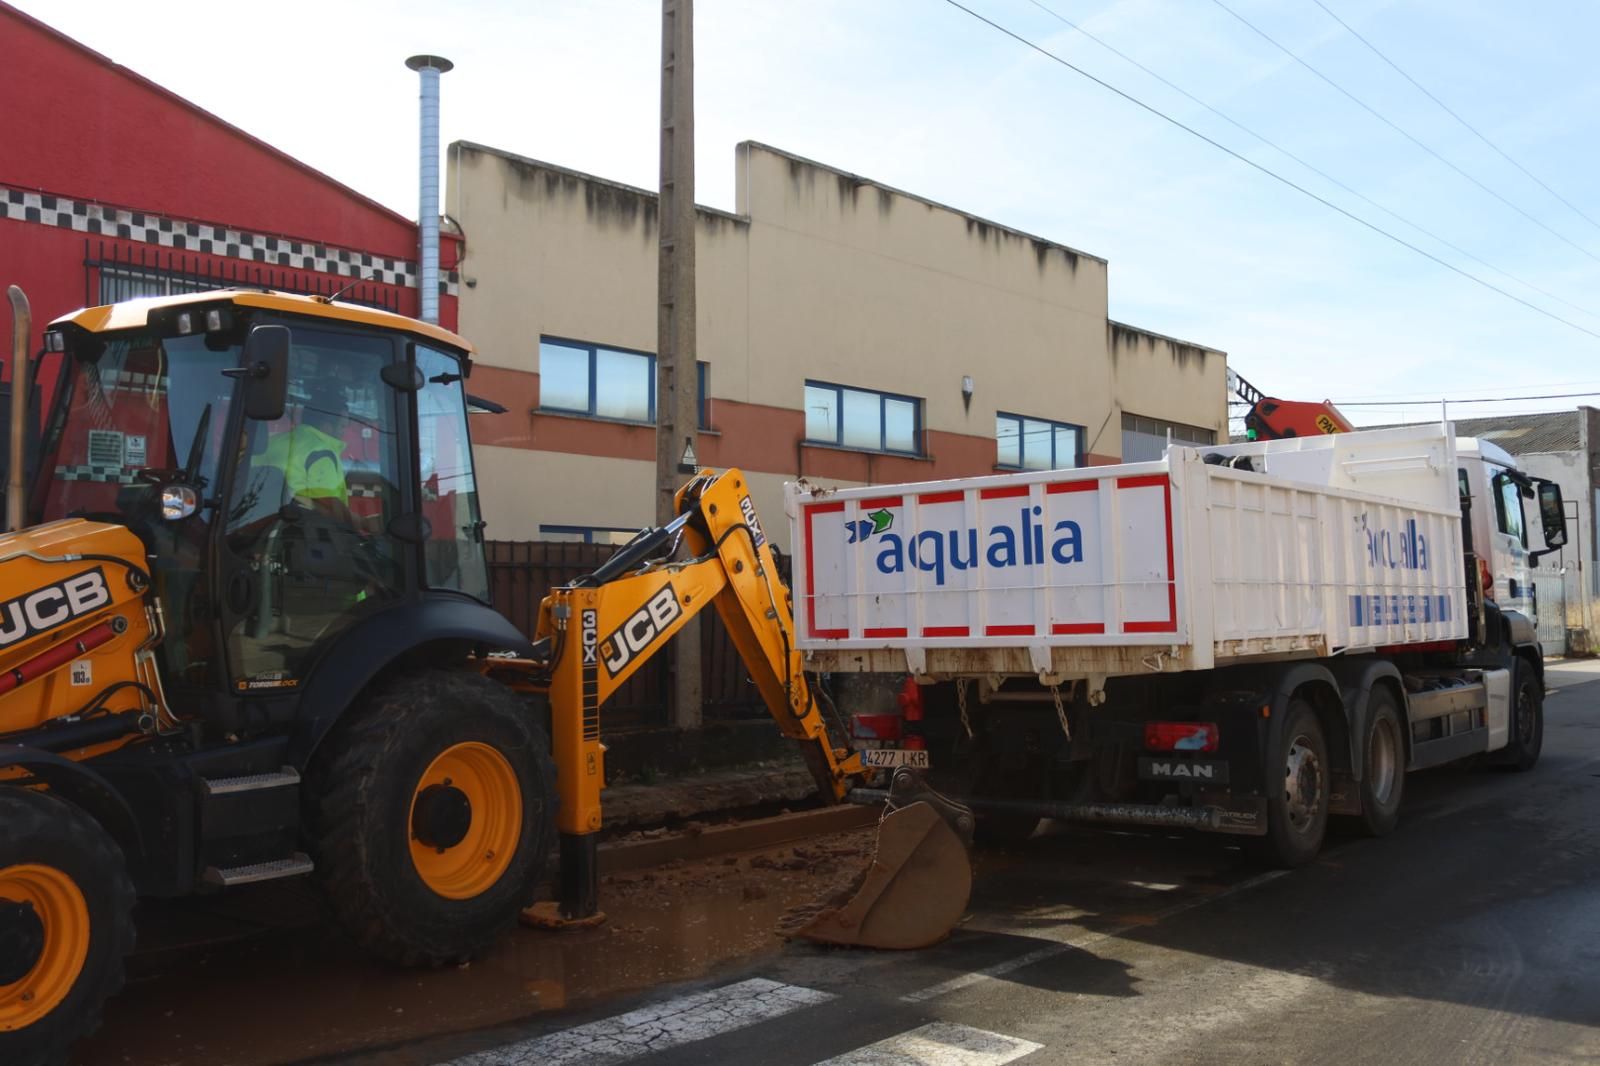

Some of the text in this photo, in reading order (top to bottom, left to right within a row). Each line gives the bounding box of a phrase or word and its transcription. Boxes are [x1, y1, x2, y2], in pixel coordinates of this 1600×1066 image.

[876, 505, 1083, 585] aqualia
[0, 571, 109, 645] JCB
[583, 611, 597, 662] 3CX
[605, 588, 681, 674] JCB
[867, 751, 926, 766] 4277 LKR
[1152, 762, 1213, 778] MAN
